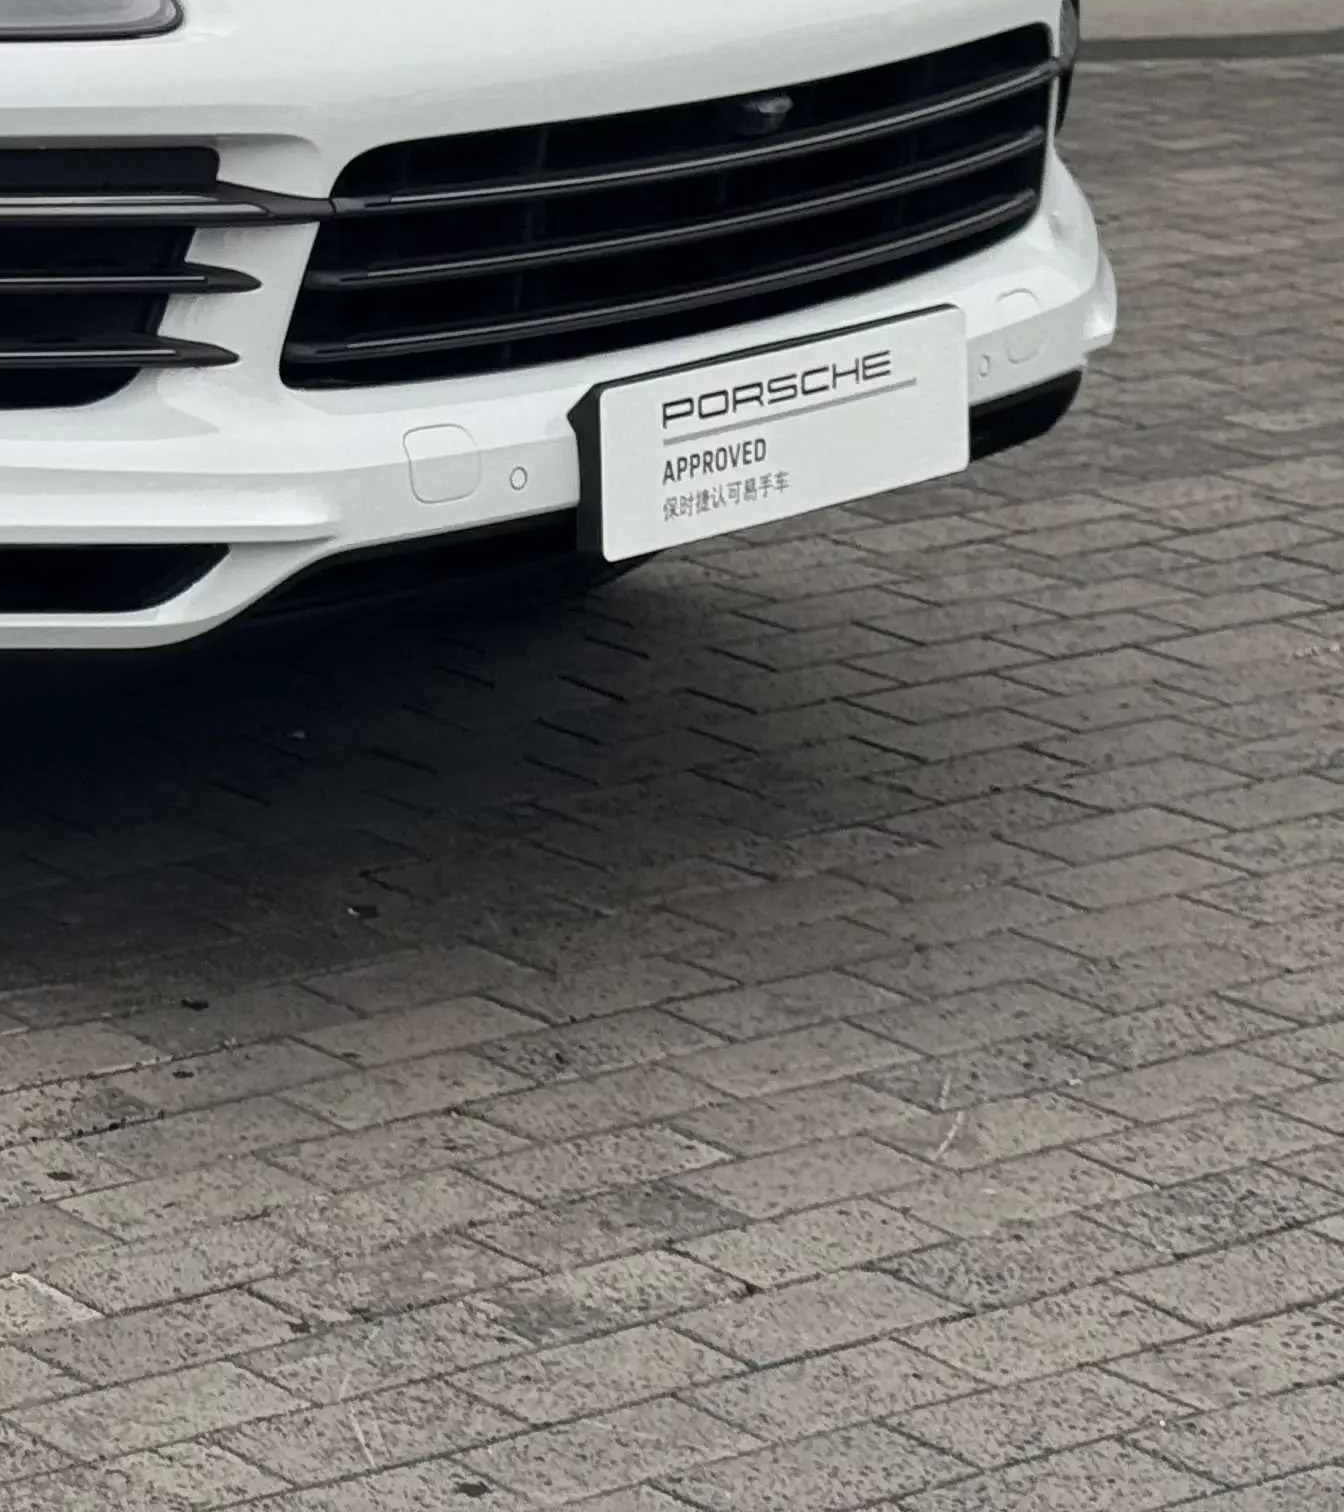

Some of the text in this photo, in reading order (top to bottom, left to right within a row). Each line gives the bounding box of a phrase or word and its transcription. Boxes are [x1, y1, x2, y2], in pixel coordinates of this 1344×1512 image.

[662, 350, 892, 429] PORSCHE
[662, 438, 767, 486] APPROVED
[662, 470, 791, 522] 保时捷认可易手车
